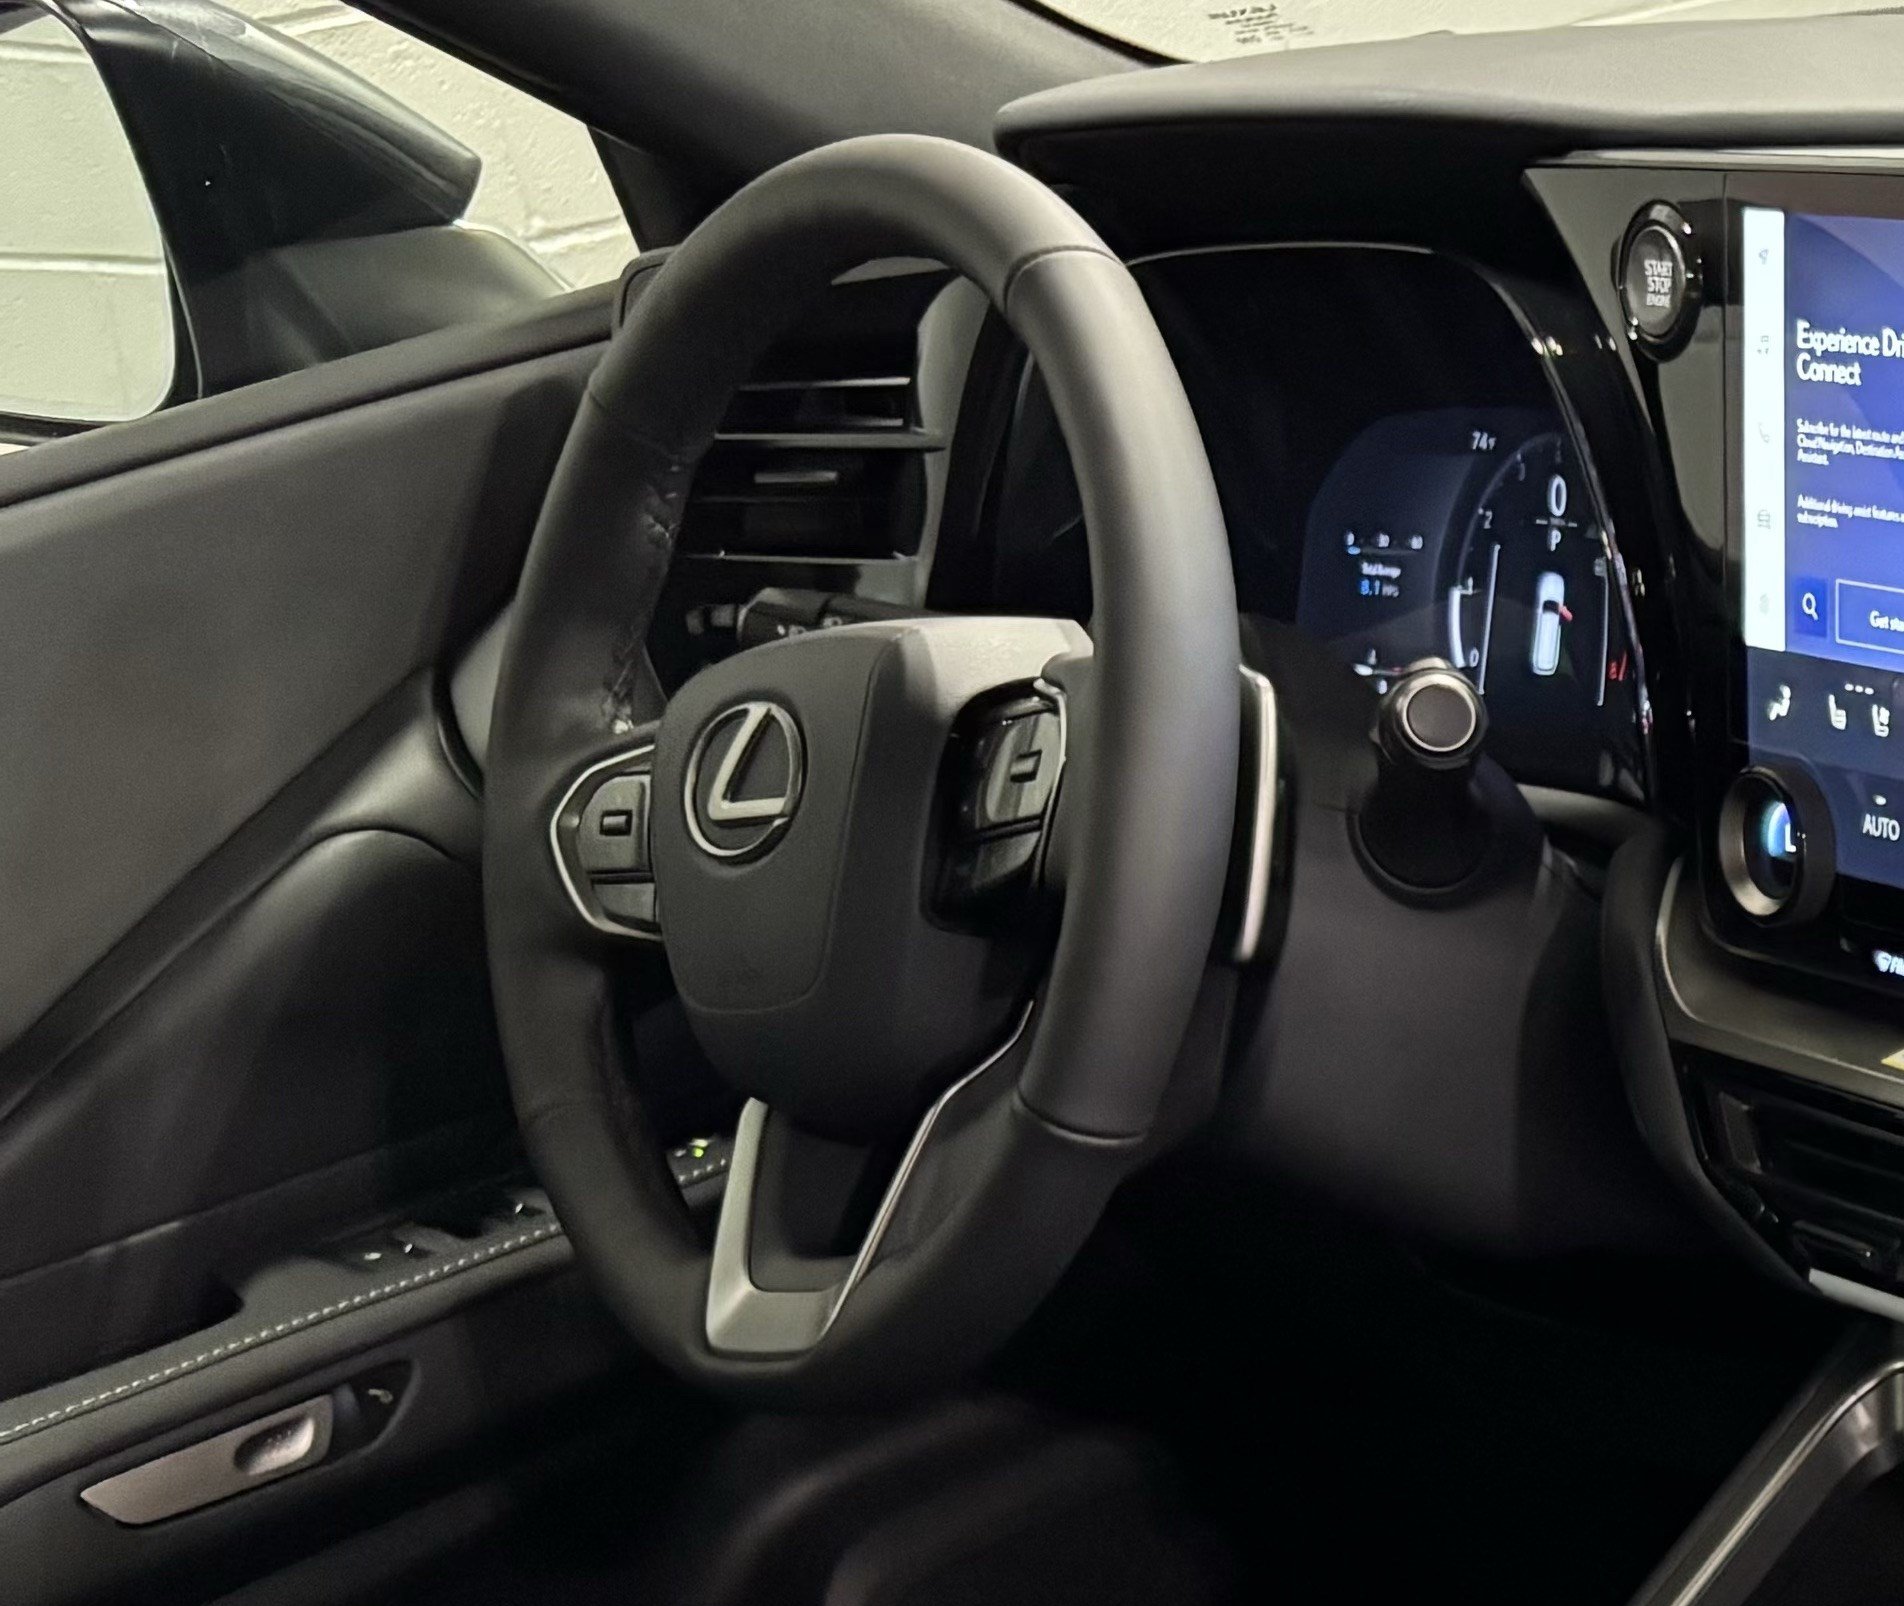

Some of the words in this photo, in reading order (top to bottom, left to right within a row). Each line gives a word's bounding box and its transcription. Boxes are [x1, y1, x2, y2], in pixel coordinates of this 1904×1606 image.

[1644, 260, 1673, 276] START
[1647, 276, 1672, 293] STOP
[1797, 318, 1880, 356] Experience
[1797, 352, 1861, 385] Connect
[1869, 610, 1889, 629] Get
[1862, 813, 1900, 842] AUTO
